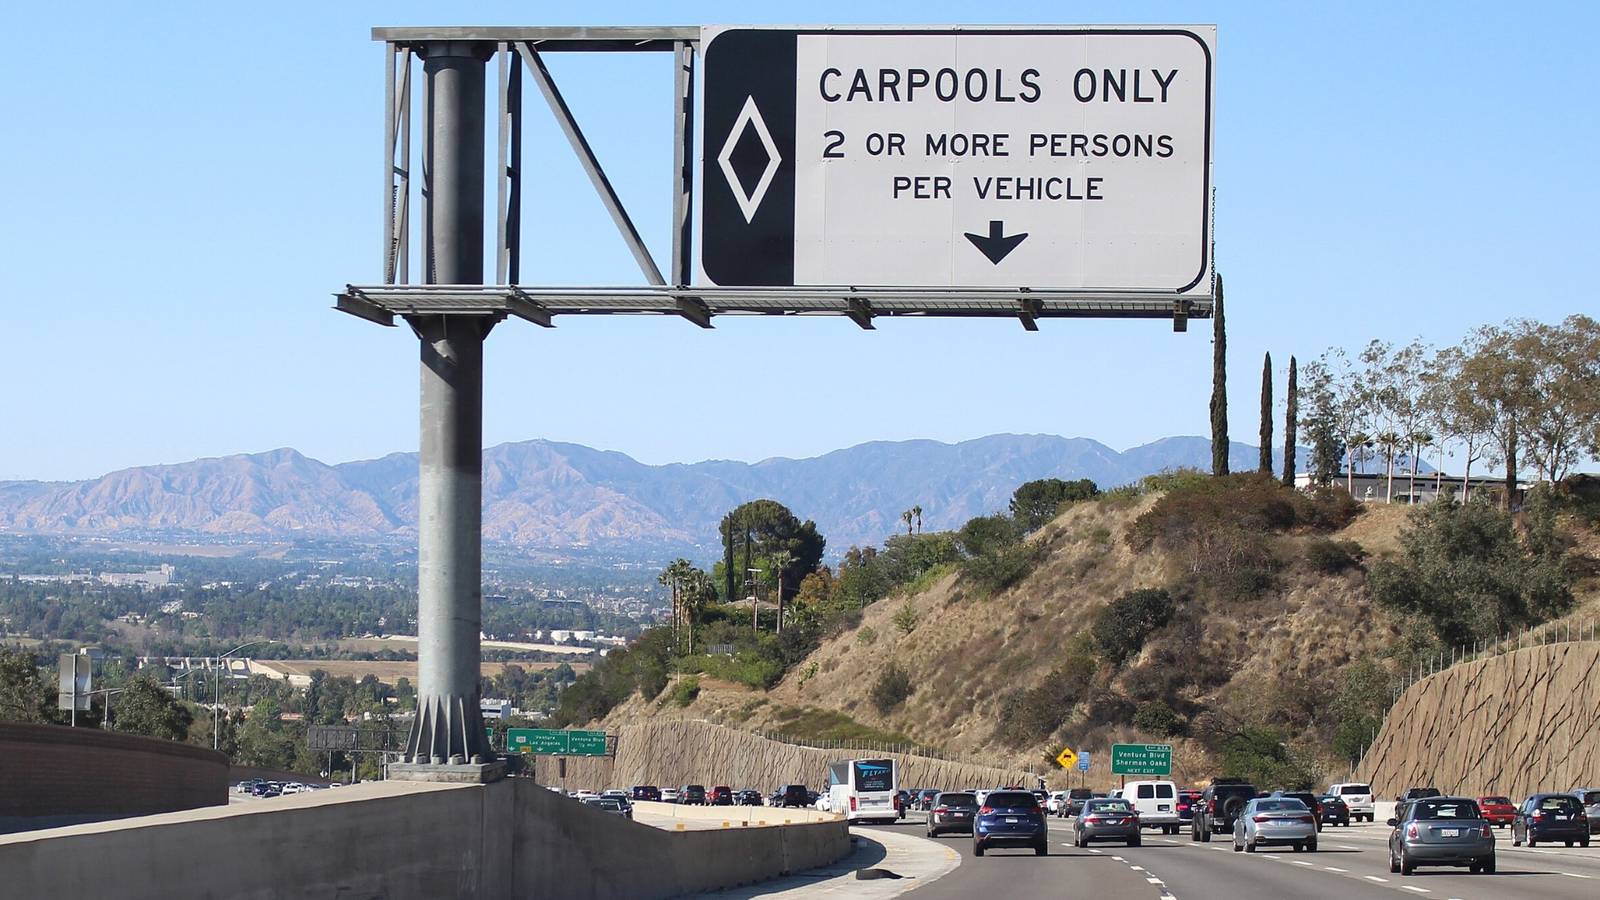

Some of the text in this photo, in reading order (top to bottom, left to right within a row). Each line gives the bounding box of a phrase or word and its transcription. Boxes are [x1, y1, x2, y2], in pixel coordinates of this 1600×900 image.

[819, 67, 1179, 103] CARPOOLS ONLY
[822, 130, 1174, 159] 2 OR MORE PERSONS
[893, 176, 1104, 200] PER VEHICLE
